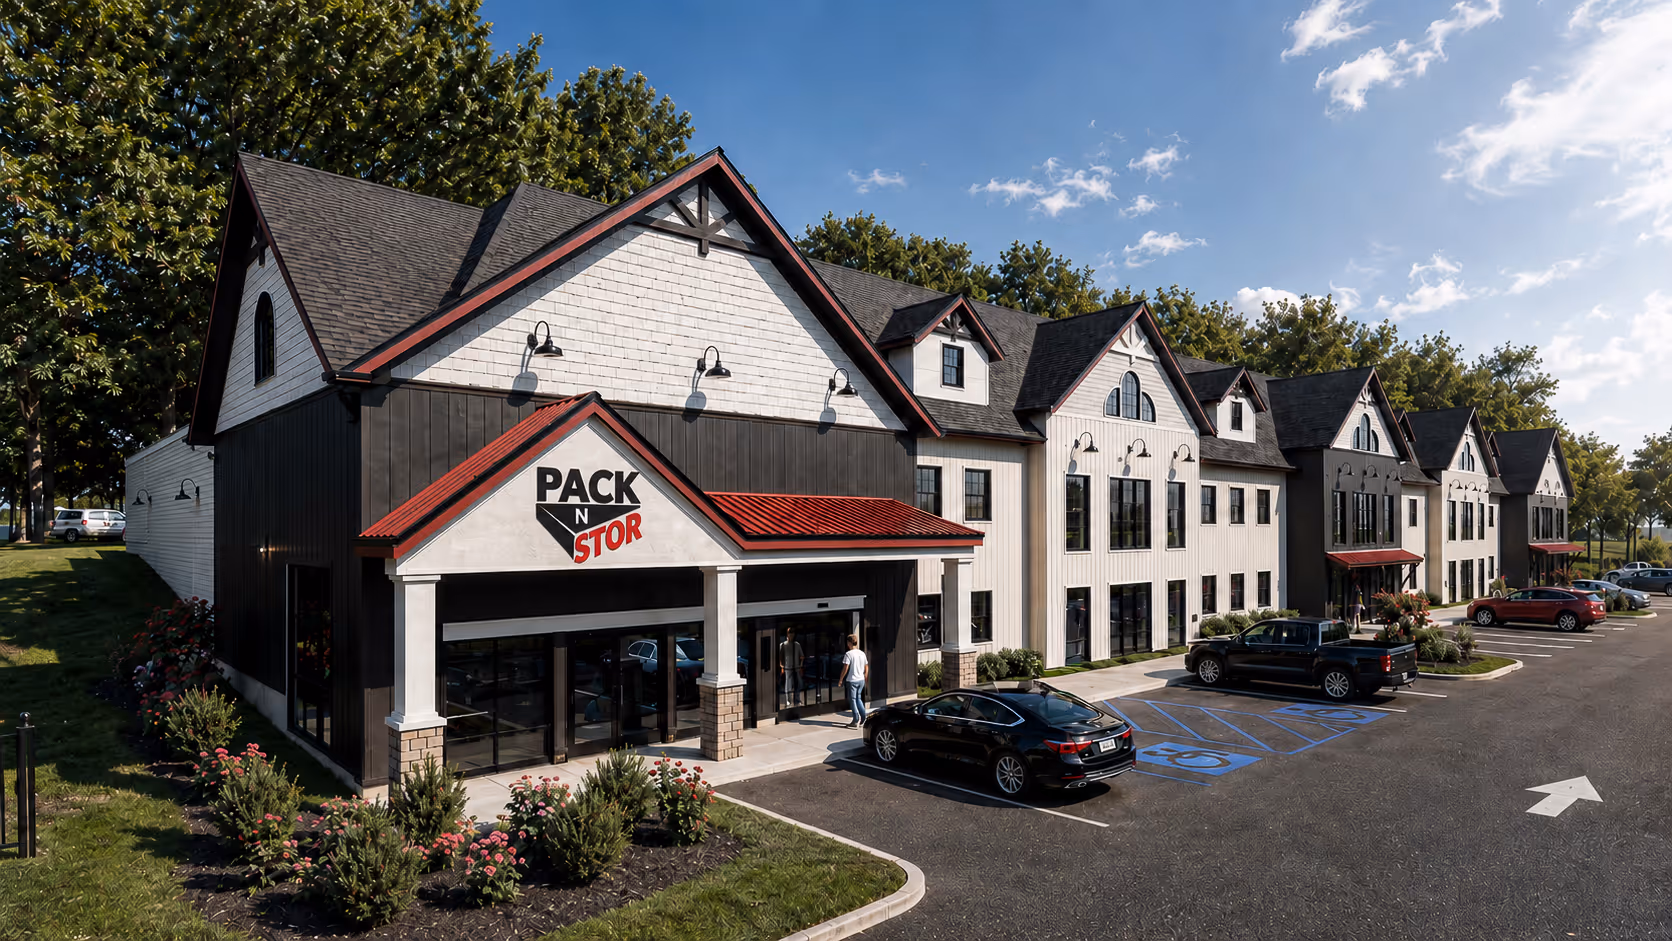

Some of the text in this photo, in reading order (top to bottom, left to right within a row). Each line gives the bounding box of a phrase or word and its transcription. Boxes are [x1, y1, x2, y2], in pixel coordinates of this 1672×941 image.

[537, 467, 641, 504] PACK
[575, 508, 588, 524] N
[574, 513, 642, 564] STOR
